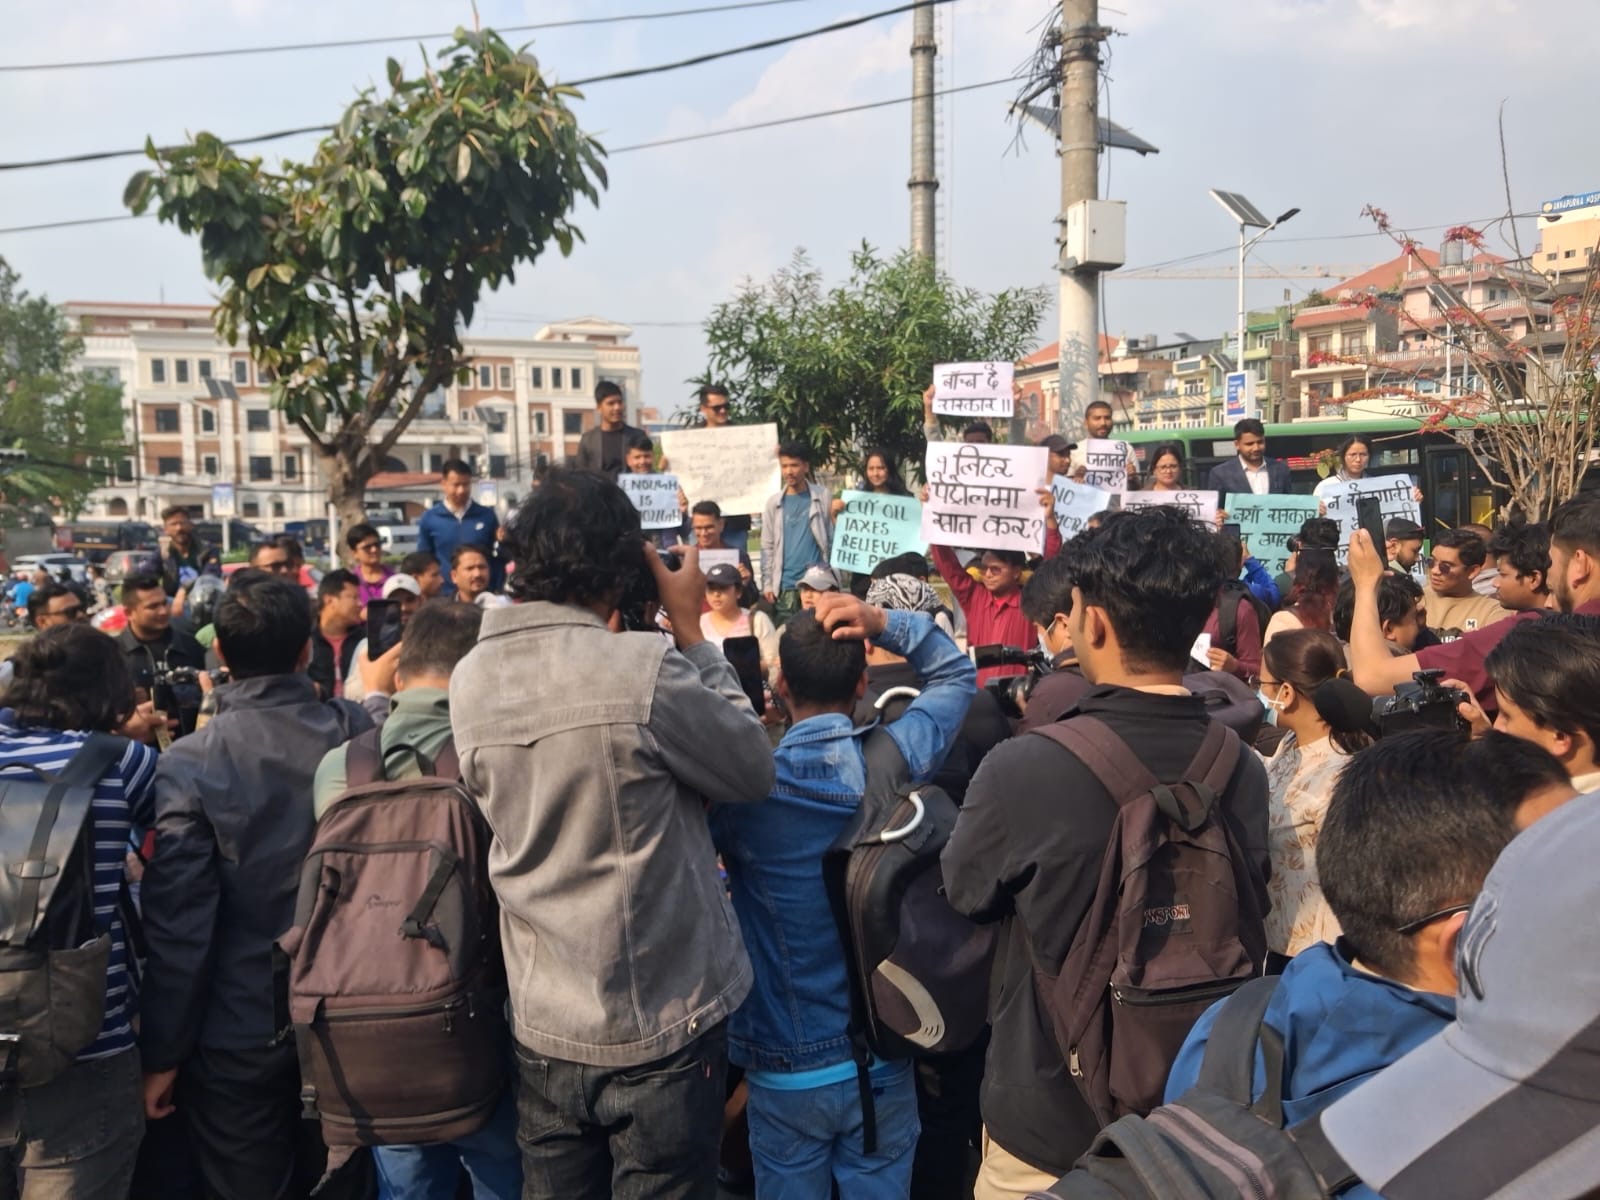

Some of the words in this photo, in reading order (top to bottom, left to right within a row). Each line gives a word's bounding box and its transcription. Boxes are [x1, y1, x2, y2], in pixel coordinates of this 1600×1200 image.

[953, 445, 1013, 478] लिटर
[639, 495, 652, 506] IS
[1052, 484, 1075, 505] NO
[883, 503, 908, 521] OIL
[845, 517, 889, 535] TAXES
[932, 511, 977, 534] सात
[841, 534, 899, 555] RELIEVE
[836, 549, 859, 565] THE
